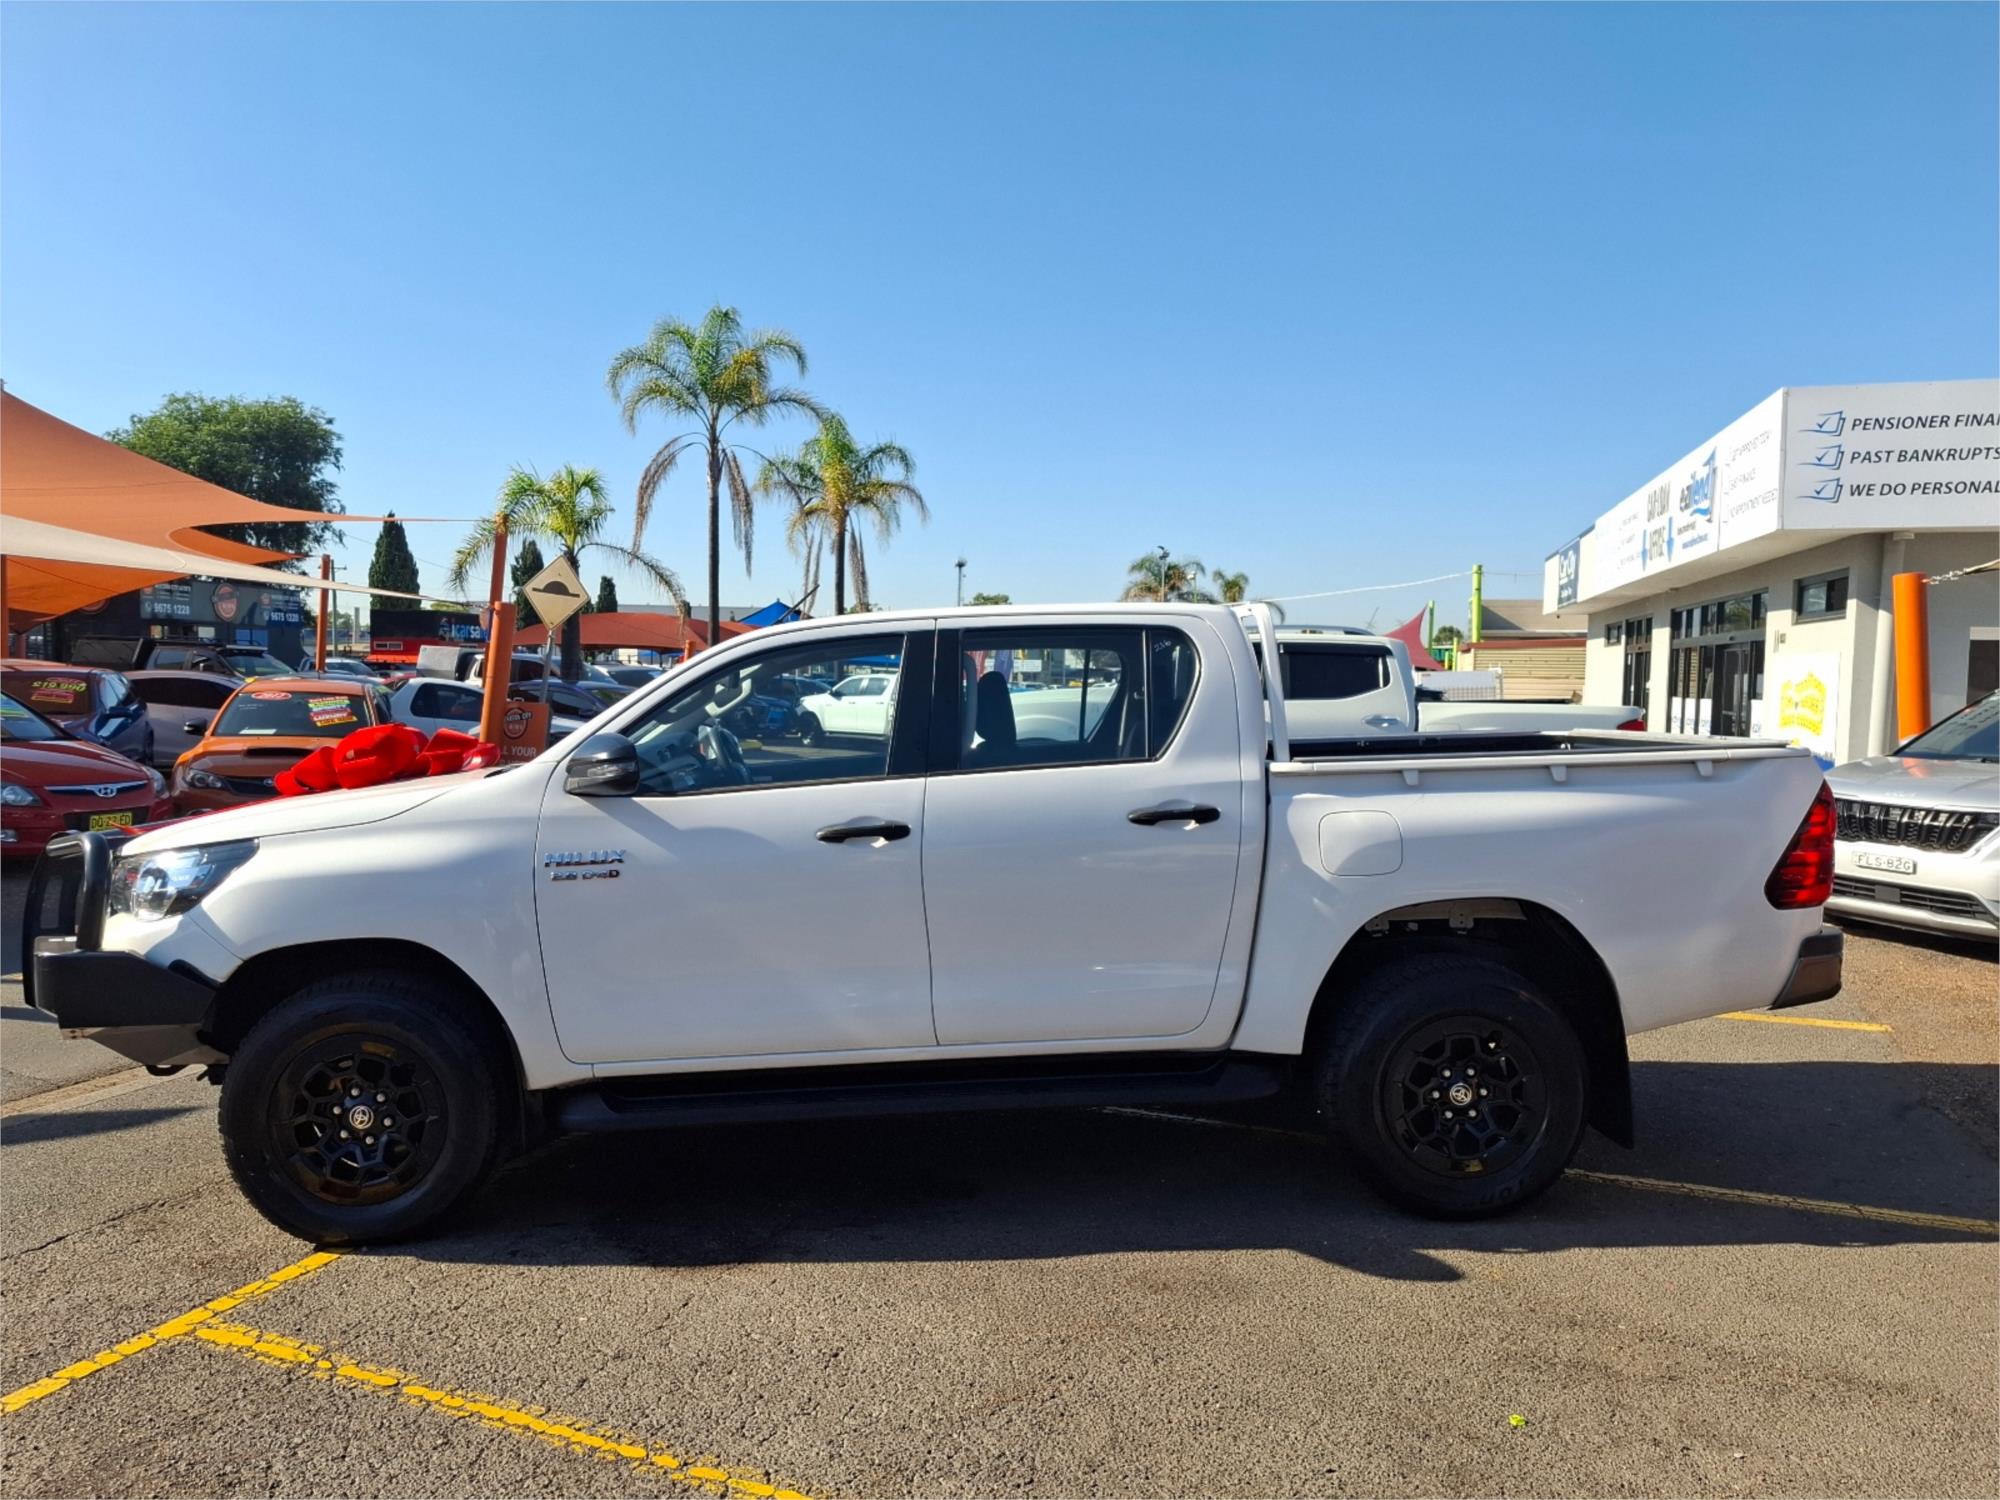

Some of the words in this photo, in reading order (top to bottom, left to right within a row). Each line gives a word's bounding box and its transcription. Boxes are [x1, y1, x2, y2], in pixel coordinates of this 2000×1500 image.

[1851, 414, 1951, 431] PENSIONER
[1850, 449, 1895, 464] PAST
[1897, 446, 2000, 463] BANKRUPTS
[1850, 483, 1877, 497] WE
[1879, 482, 1907, 496] DO
[1910, 480, 2000, 495] PERSONAL
[511, 745, 537, 757] YOUR
[544, 850, 625, 867] HILUX
